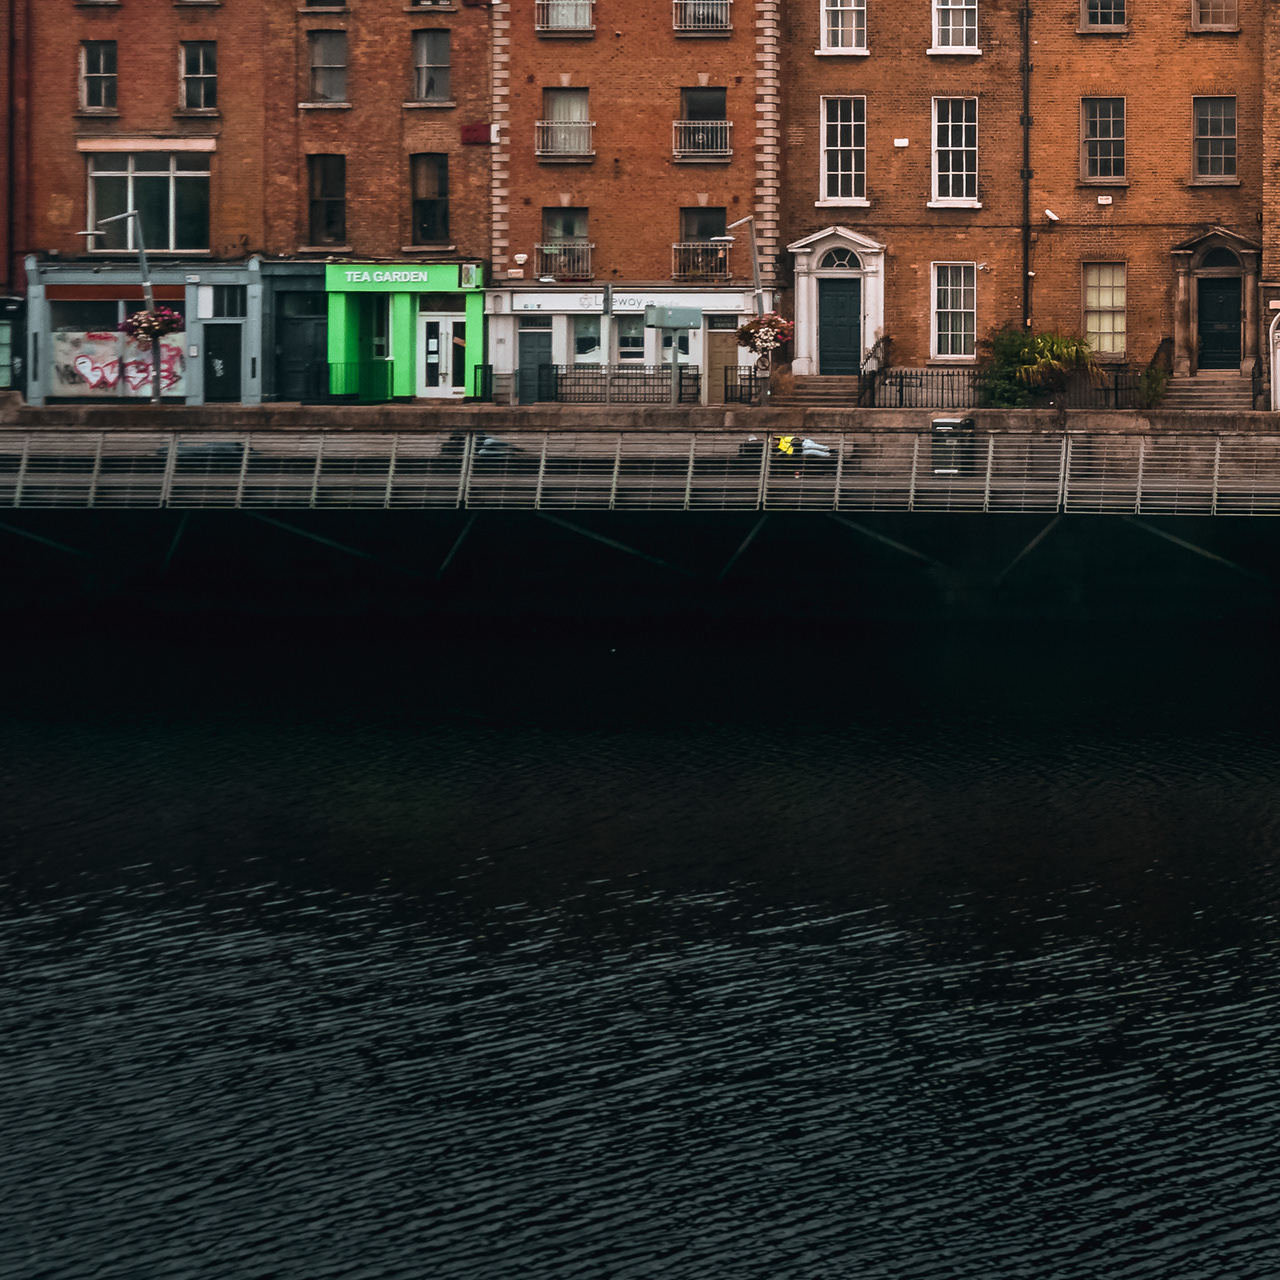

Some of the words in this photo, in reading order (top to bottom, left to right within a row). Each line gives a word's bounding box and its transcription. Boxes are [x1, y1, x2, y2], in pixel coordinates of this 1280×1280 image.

[345, 271, 371, 282] TEA
[373, 271, 428, 282] GARDEN
[594, 295, 643, 308] Leway
